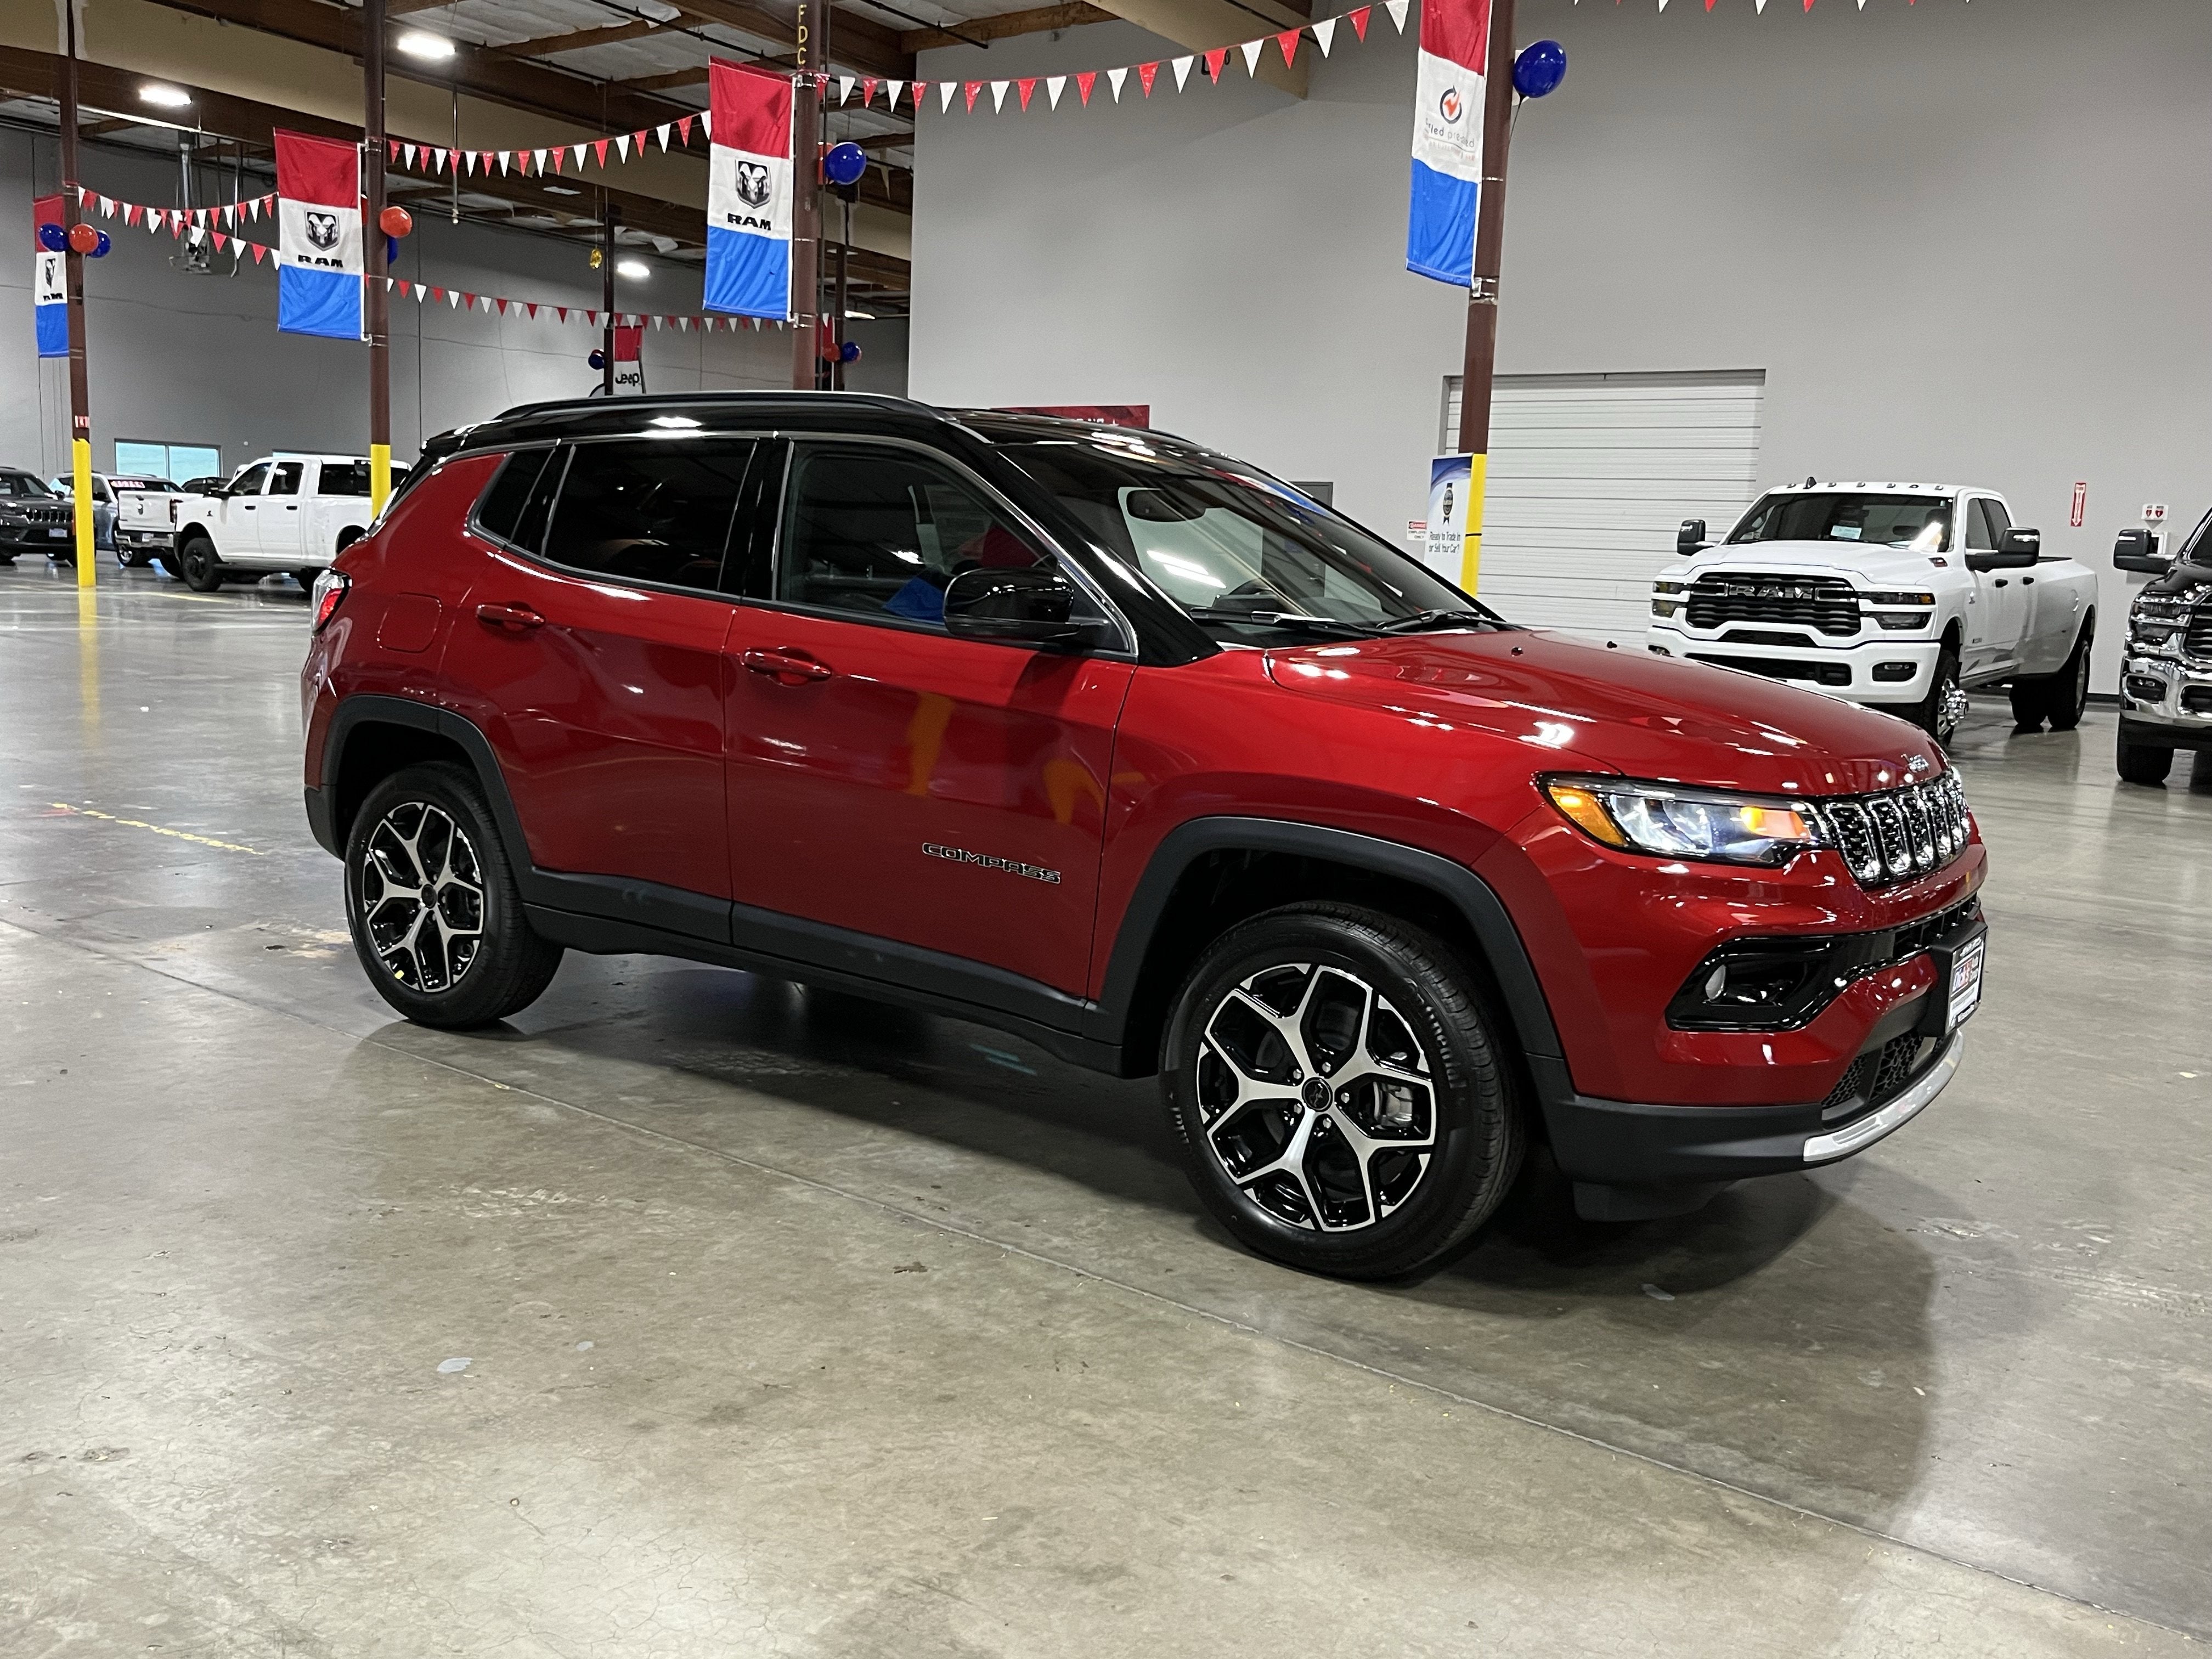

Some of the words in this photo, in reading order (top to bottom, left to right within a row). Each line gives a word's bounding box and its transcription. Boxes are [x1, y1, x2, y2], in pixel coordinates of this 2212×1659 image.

[727, 213, 771, 230] RAM
[298, 255, 343, 268] RAM
[43, 293, 63, 301] AM
[616, 372, 640, 387] Jeep
[1430, 532, 1440, 543] Ready
[1441, 532, 1445, 540] to
[1446, 532, 1455, 541] Trade
[1442, 544, 1450, 553] Your
[1729, 585, 1813, 599] RAM
[922, 842, 1061, 884] COMPASS
